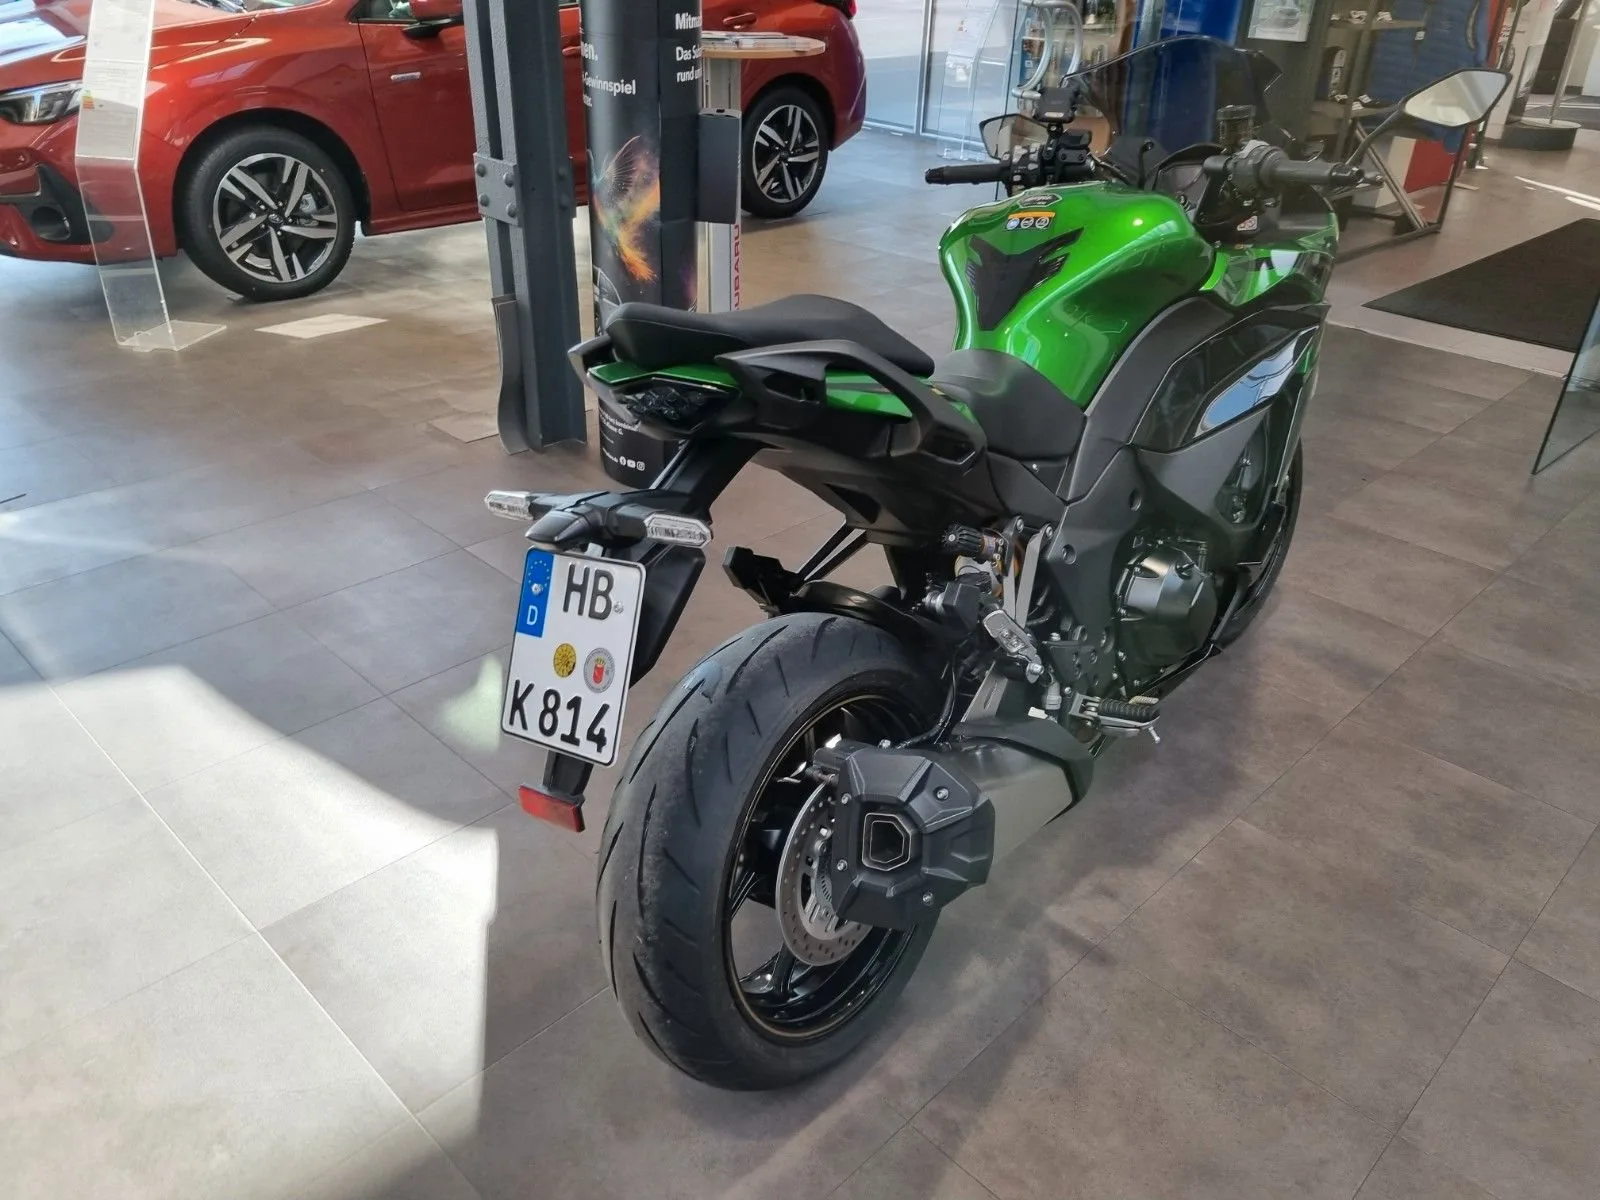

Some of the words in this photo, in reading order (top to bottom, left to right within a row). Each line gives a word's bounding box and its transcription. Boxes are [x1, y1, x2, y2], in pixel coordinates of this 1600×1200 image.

[675, 46, 692, 61] Das
[676, 66, 694, 82] rund
[562, 563, 615, 620] HB
[526, 604, 539, 626] D
[508, 679, 535, 731] K
[538, 688, 610, 753] 814
